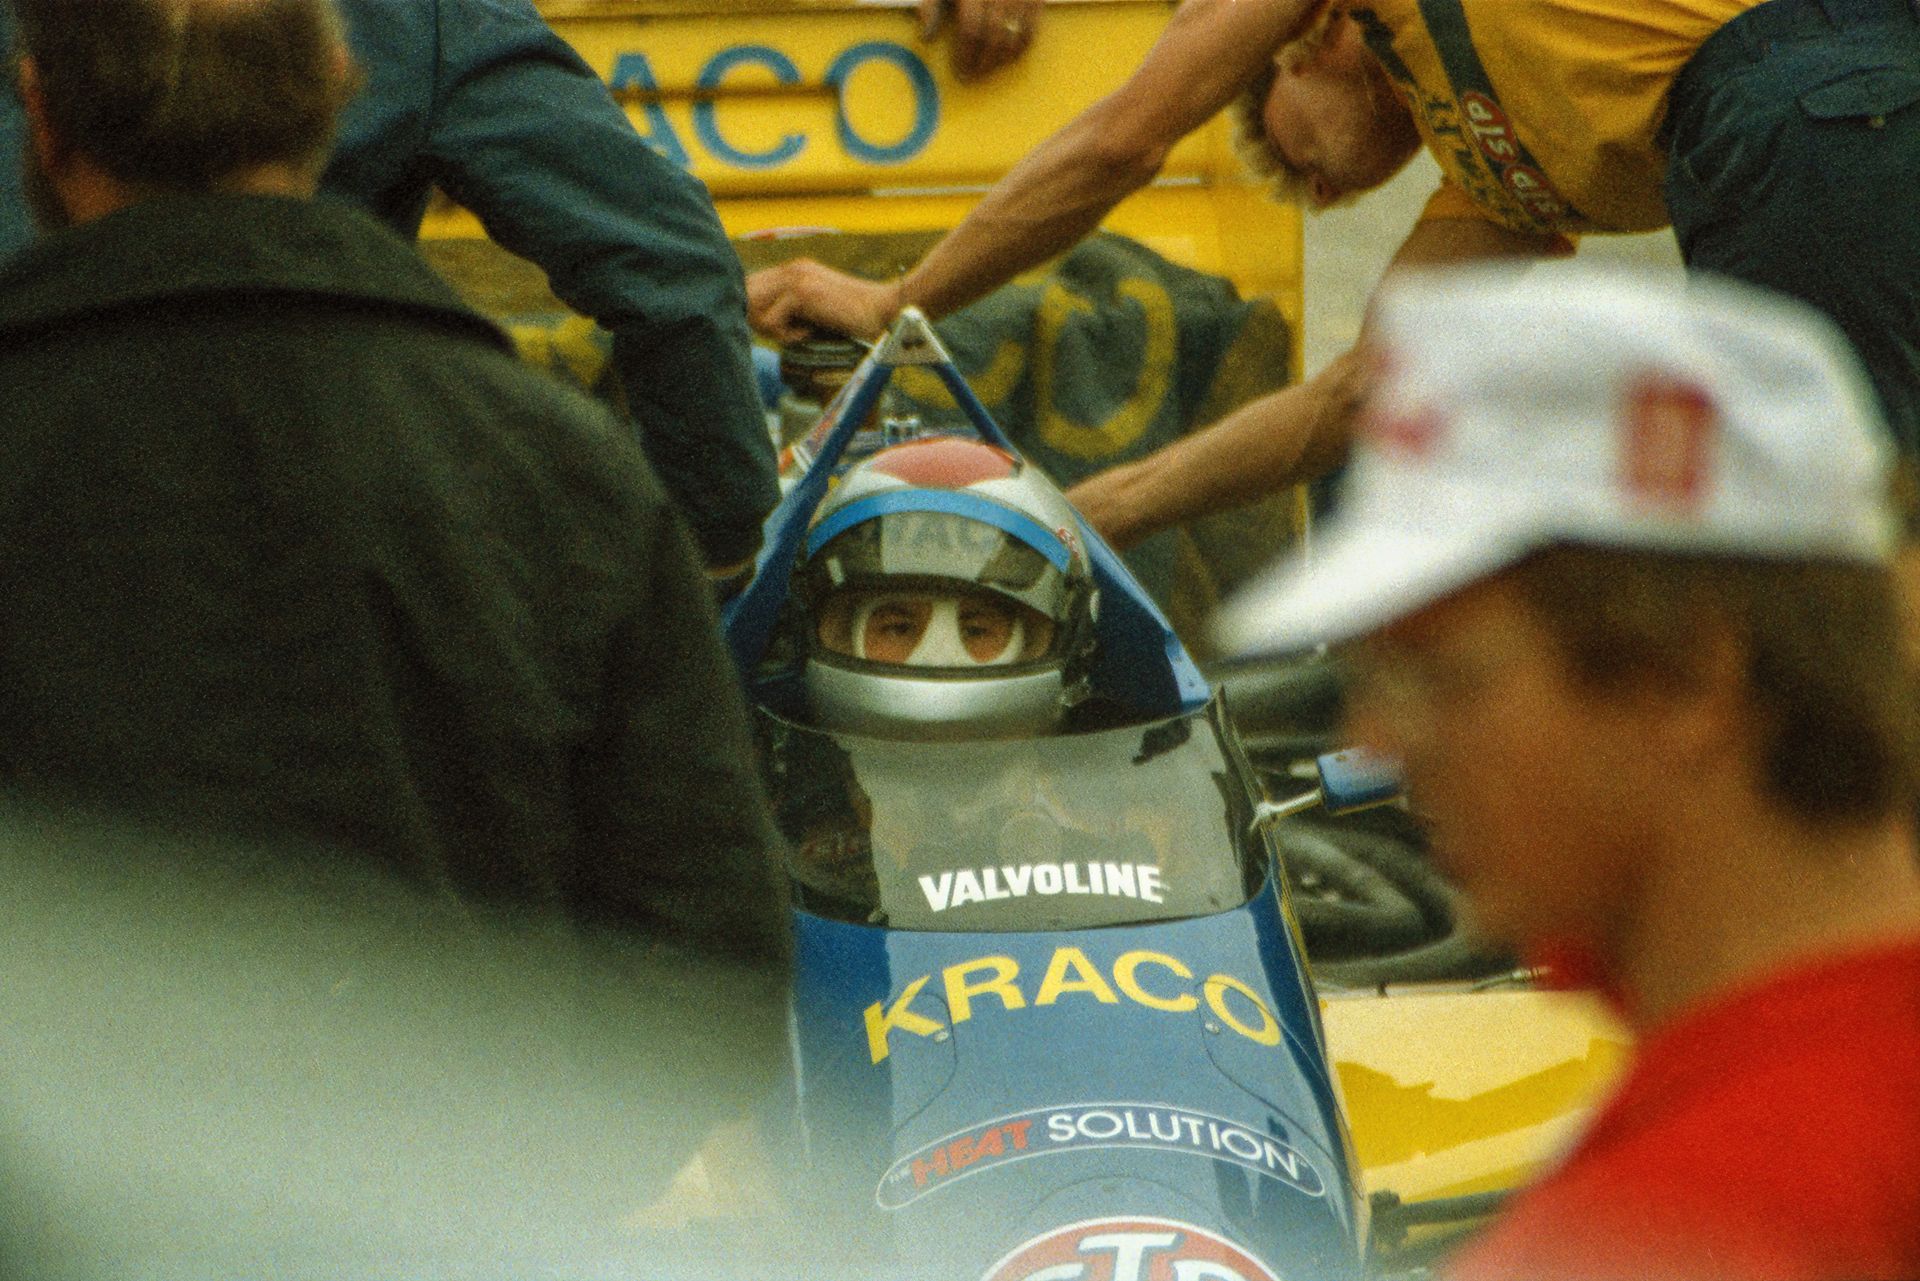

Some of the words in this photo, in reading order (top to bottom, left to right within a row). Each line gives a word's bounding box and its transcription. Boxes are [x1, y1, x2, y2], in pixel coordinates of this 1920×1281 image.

[1465, 99, 1516, 158] STP
[918, 861, 1164, 912] VALVOLINE
[863, 946, 1281, 1065] KRACO
[911, 1119, 1033, 1186] HEAT
[1047, 1111, 1300, 1181] SOLUTION
